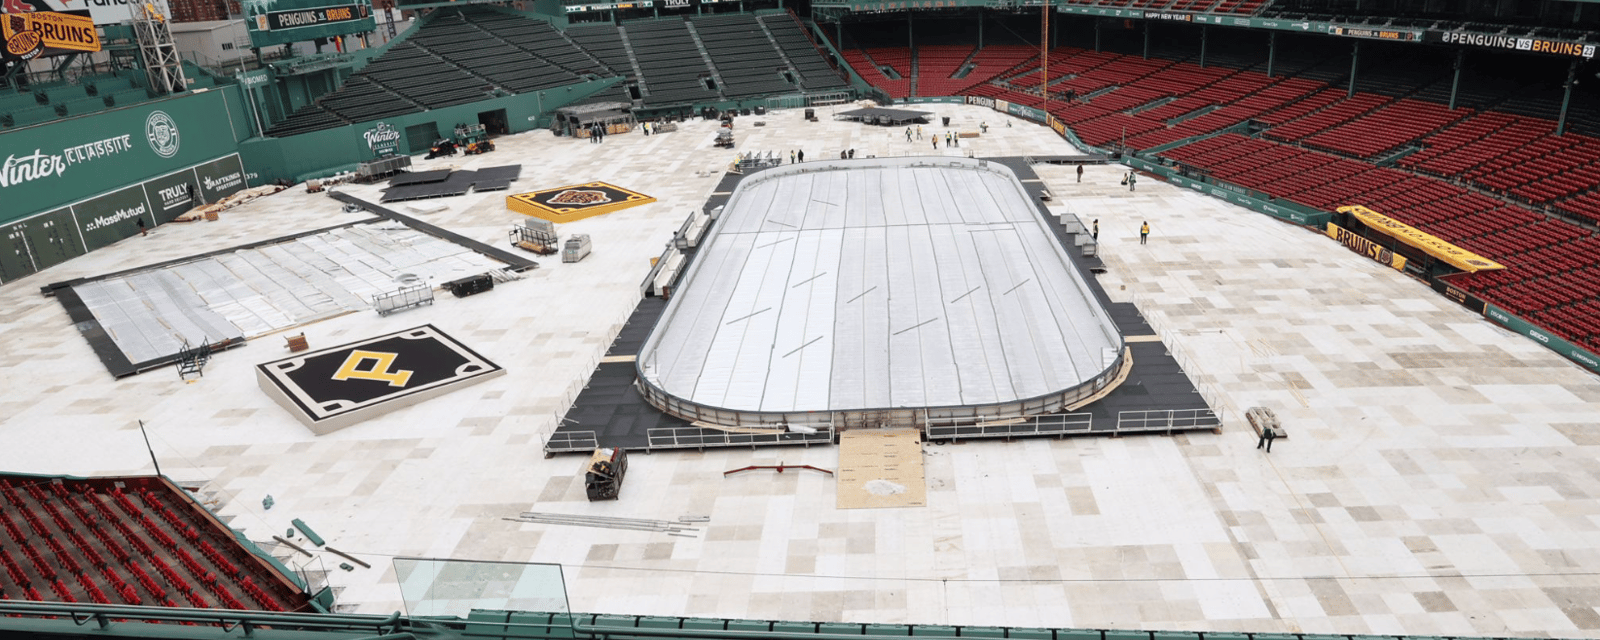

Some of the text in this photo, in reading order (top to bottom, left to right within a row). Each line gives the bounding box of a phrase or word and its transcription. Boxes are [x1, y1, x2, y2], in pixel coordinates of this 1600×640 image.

[31, 13, 63, 22] BOSTON
[278, 11, 318, 27] PENGUINS
[326, 7, 352, 21] BRUINS
[32, 21, 94, 43] BRUINS
[1348, 29, 1372, 37] PENGUINS
[9, 32, 38, 53] BRUINS
[1450, 33, 1594, 57] PENGUINS VS BRUINS 23
[21, 48, 40, 60] BOSTON
[968, 95, 995, 108] PENGUINS
[363, 129, 400, 149] Winter
[64, 134, 132, 166] CLASSIC
[158, 182, 188, 202] TRULY
[94, 202, 146, 229] MassMutual
[1336, 226, 1379, 260] BRUINS
[1446, 286, 1467, 300] BOSTON
[1529, 329, 1549, 343] GEICO
